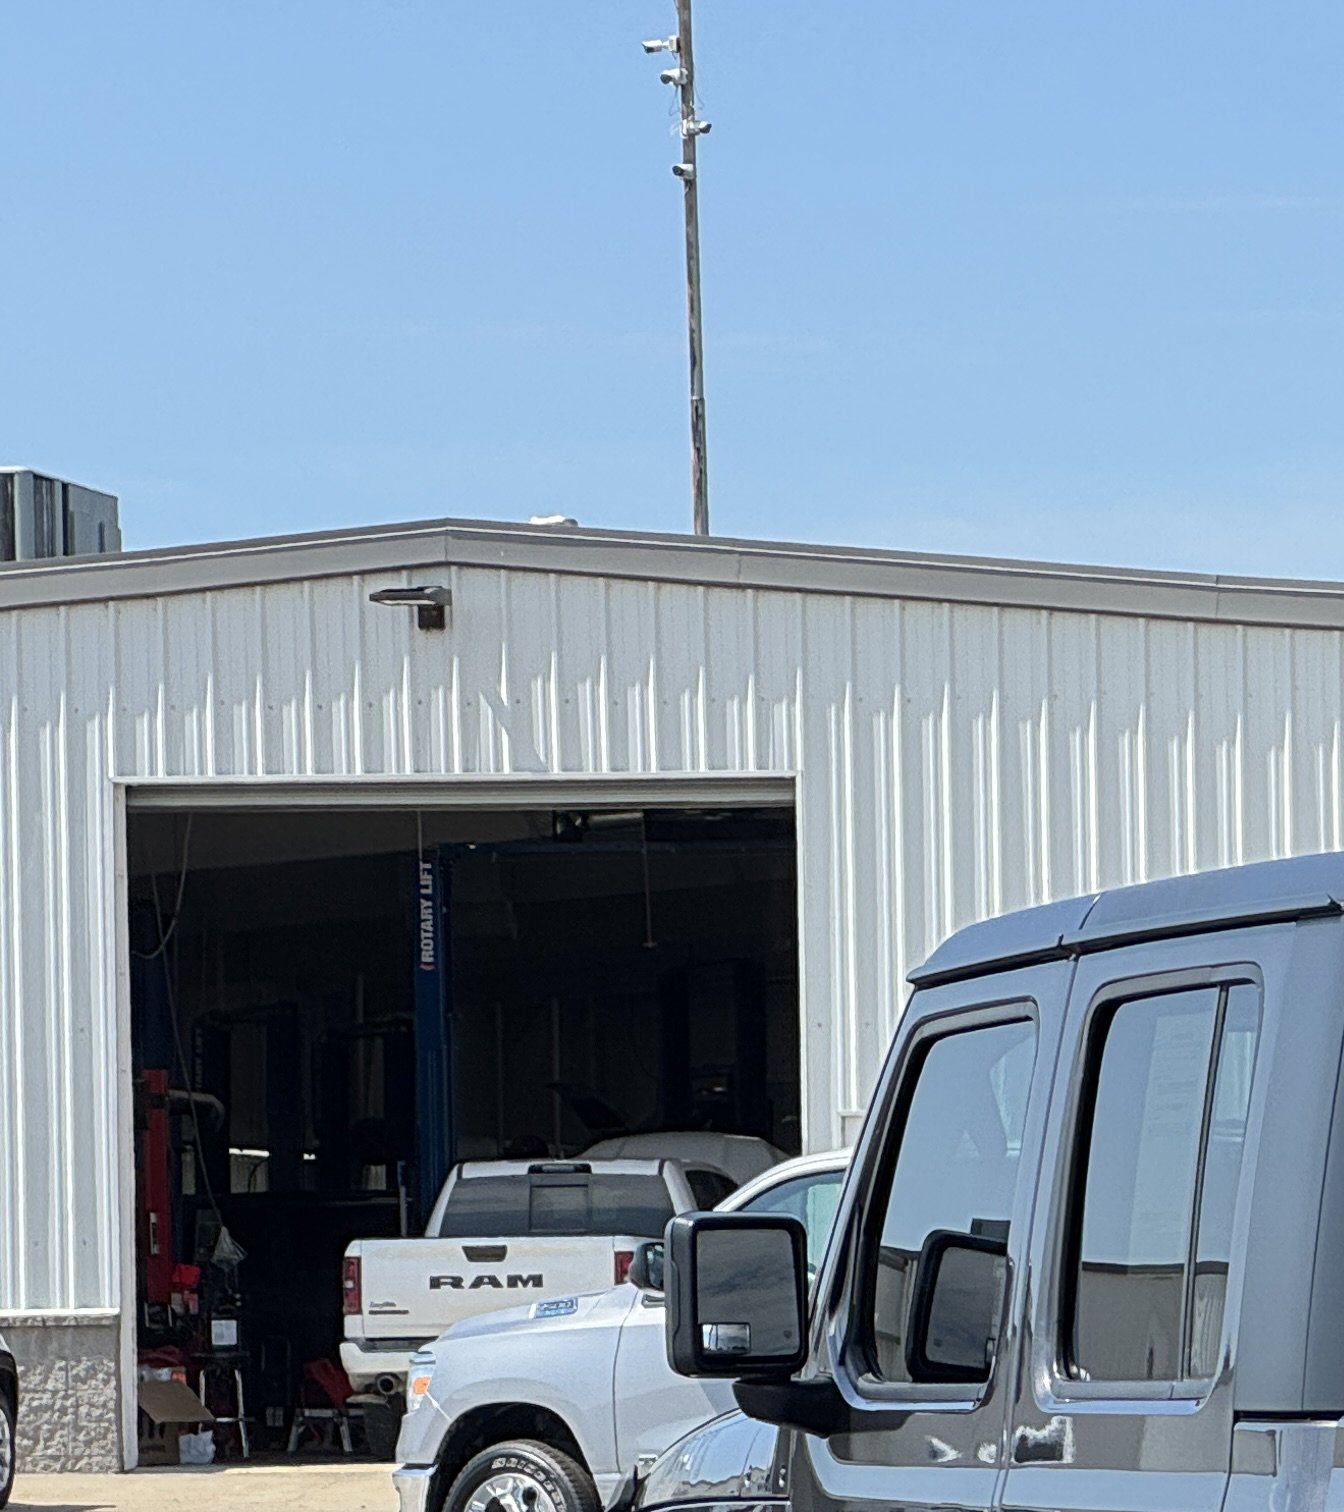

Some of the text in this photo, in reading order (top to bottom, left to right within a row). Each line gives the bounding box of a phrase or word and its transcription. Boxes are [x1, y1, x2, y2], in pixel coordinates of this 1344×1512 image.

[419, 860, 435, 963] ROTARY LIFT
[429, 1273, 544, 1290] RAM
